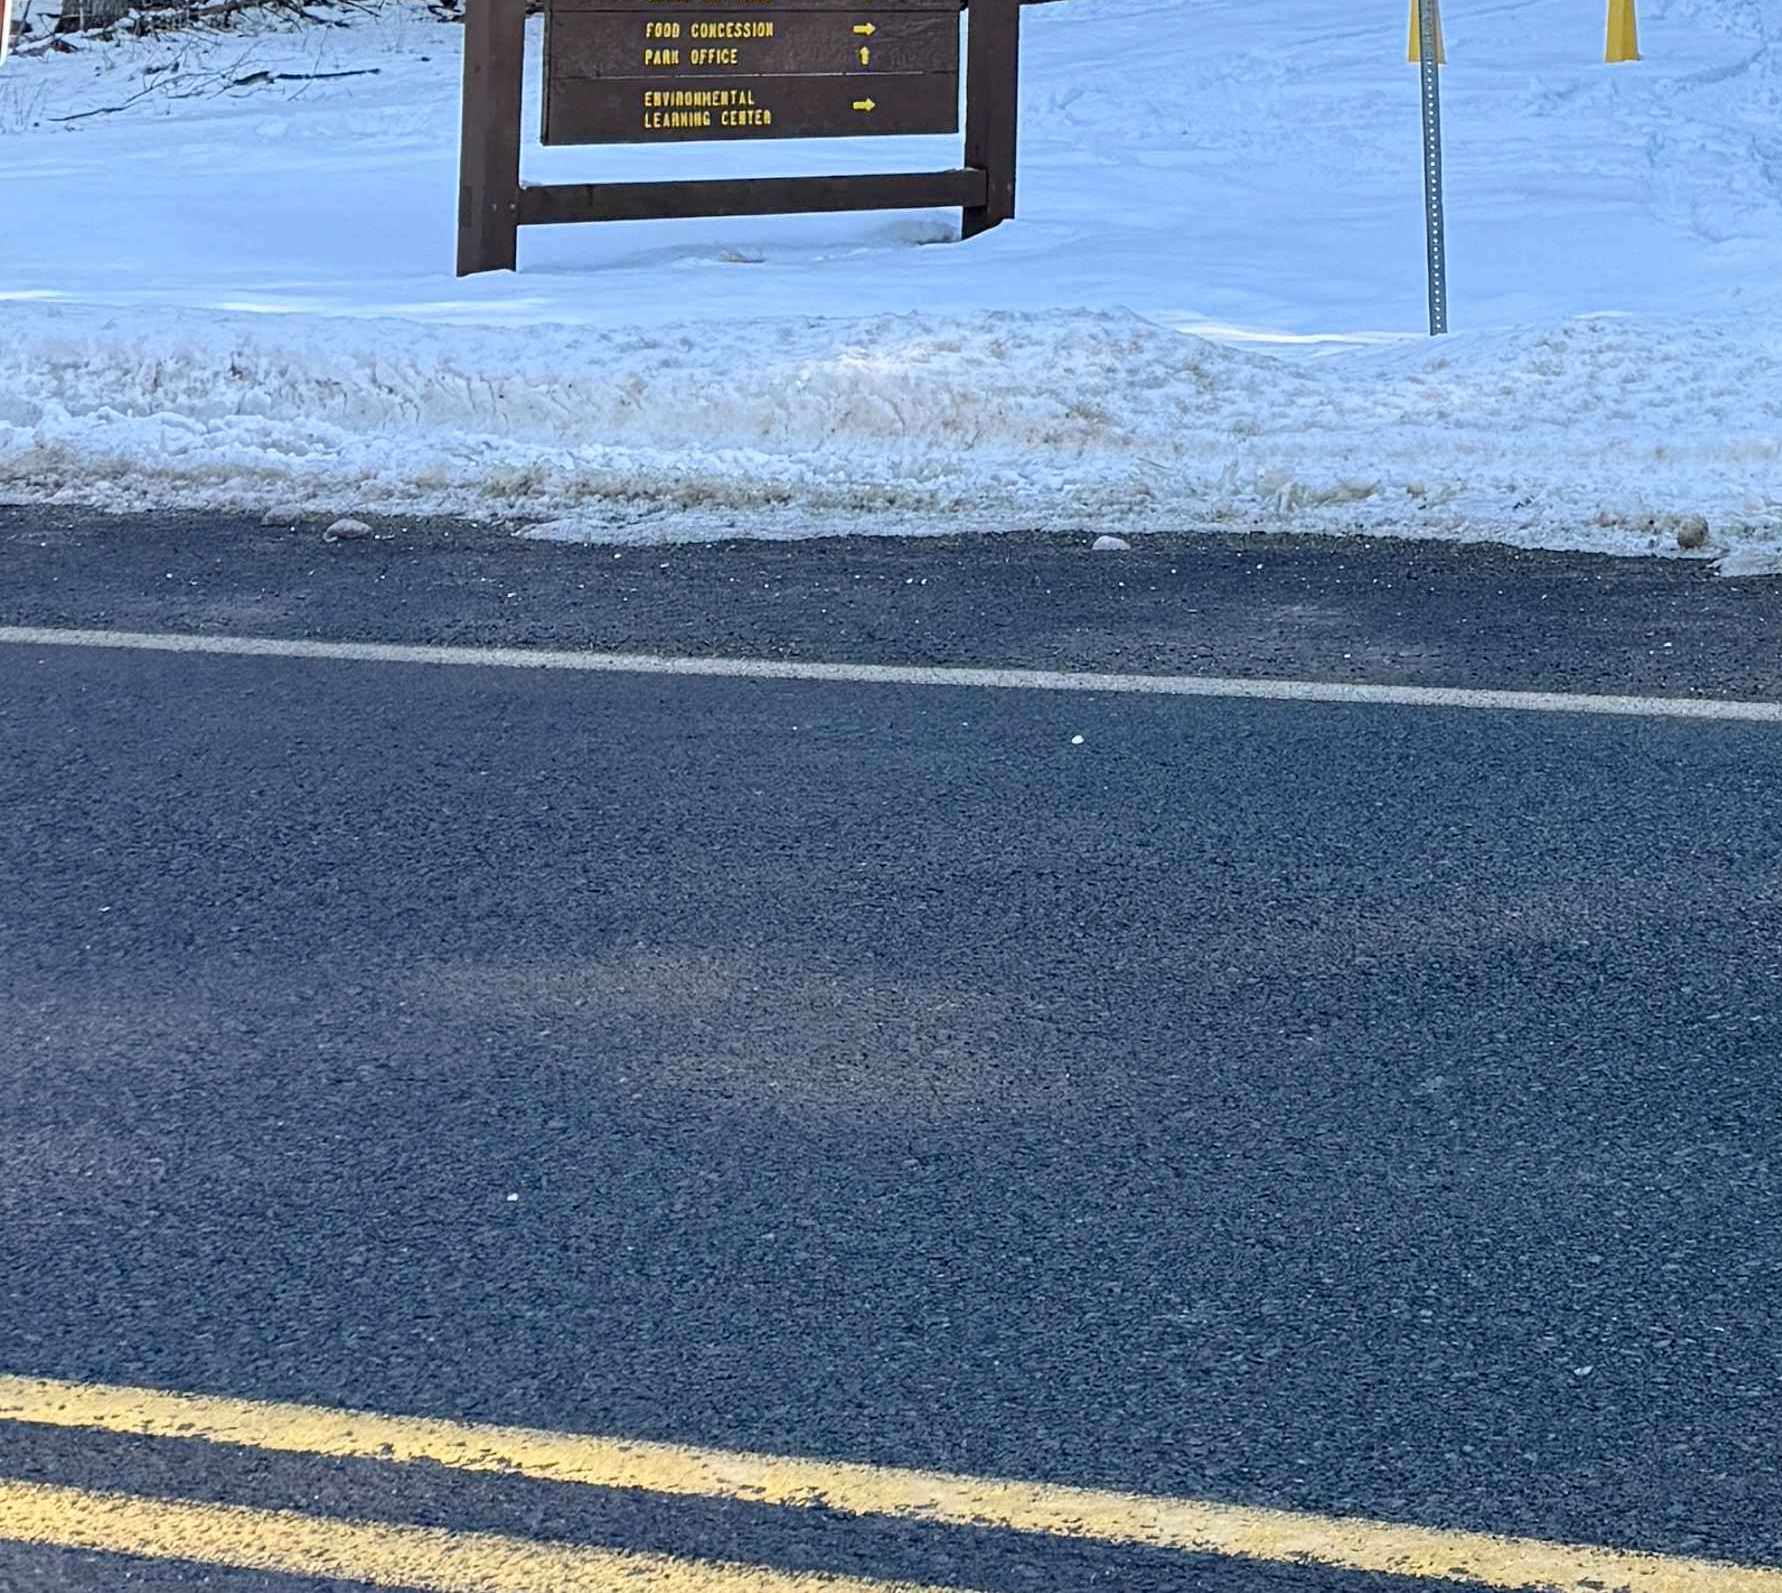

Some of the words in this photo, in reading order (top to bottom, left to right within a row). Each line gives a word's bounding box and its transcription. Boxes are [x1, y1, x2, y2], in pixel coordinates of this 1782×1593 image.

[646, 22, 680, 38] FOOD
[691, 22, 774, 38] CONCESSION
[644, 49, 679, 65] PARK
[691, 48, 738, 64] OFFICE
[644, 90, 755, 107] ENVIRONMENTAL
[644, 111, 711, 129] LEARNING
[721, 109, 772, 126] CENTER
